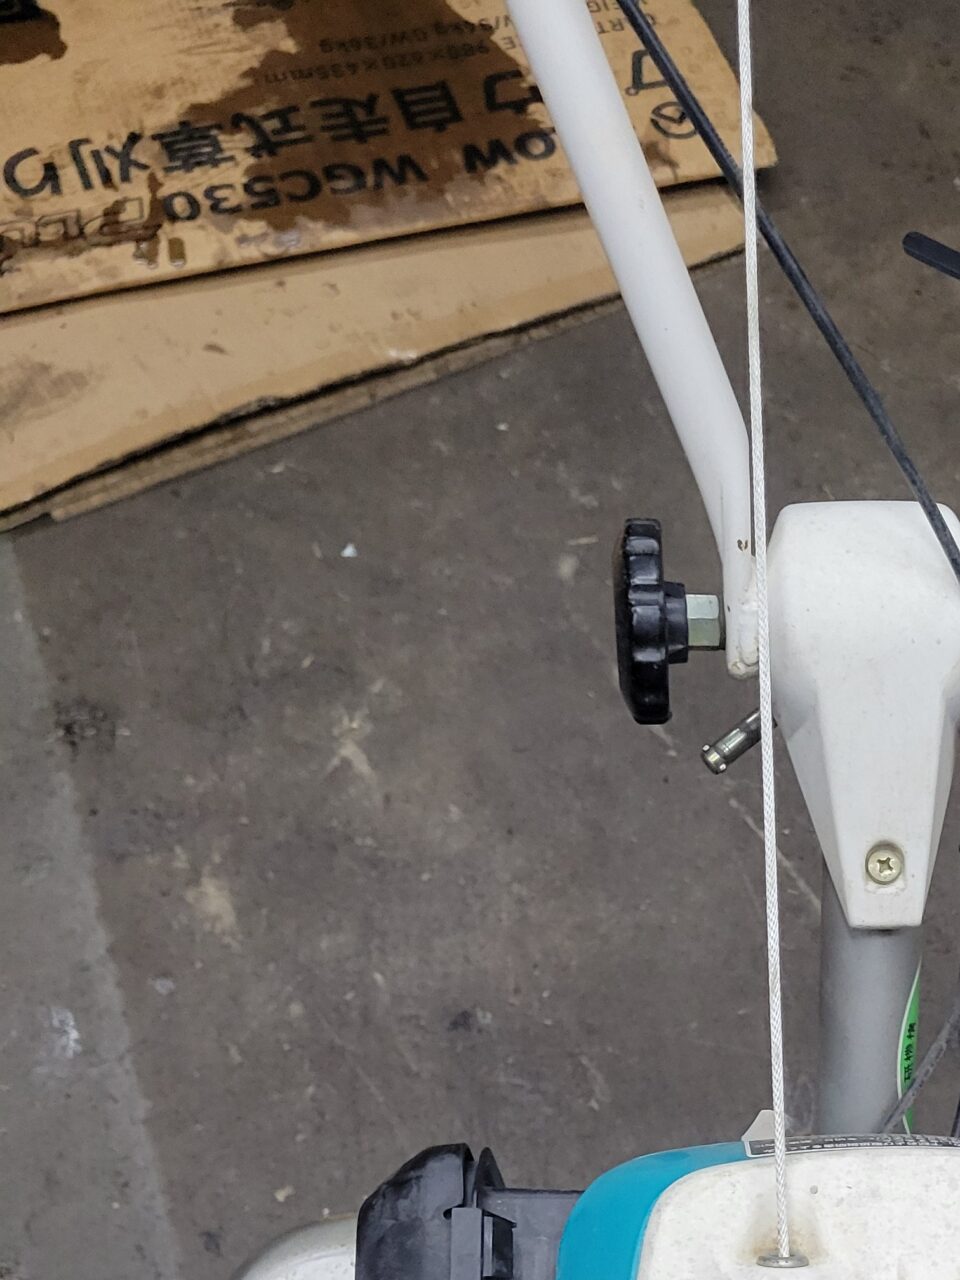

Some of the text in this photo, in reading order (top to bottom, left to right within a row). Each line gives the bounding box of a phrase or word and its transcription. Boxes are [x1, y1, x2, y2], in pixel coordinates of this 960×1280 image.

[3, 49, 668, 198] プウ自走式草刈り
[463, 128, 556, 174] OW
[162, 154, 430, 222] WGC530
